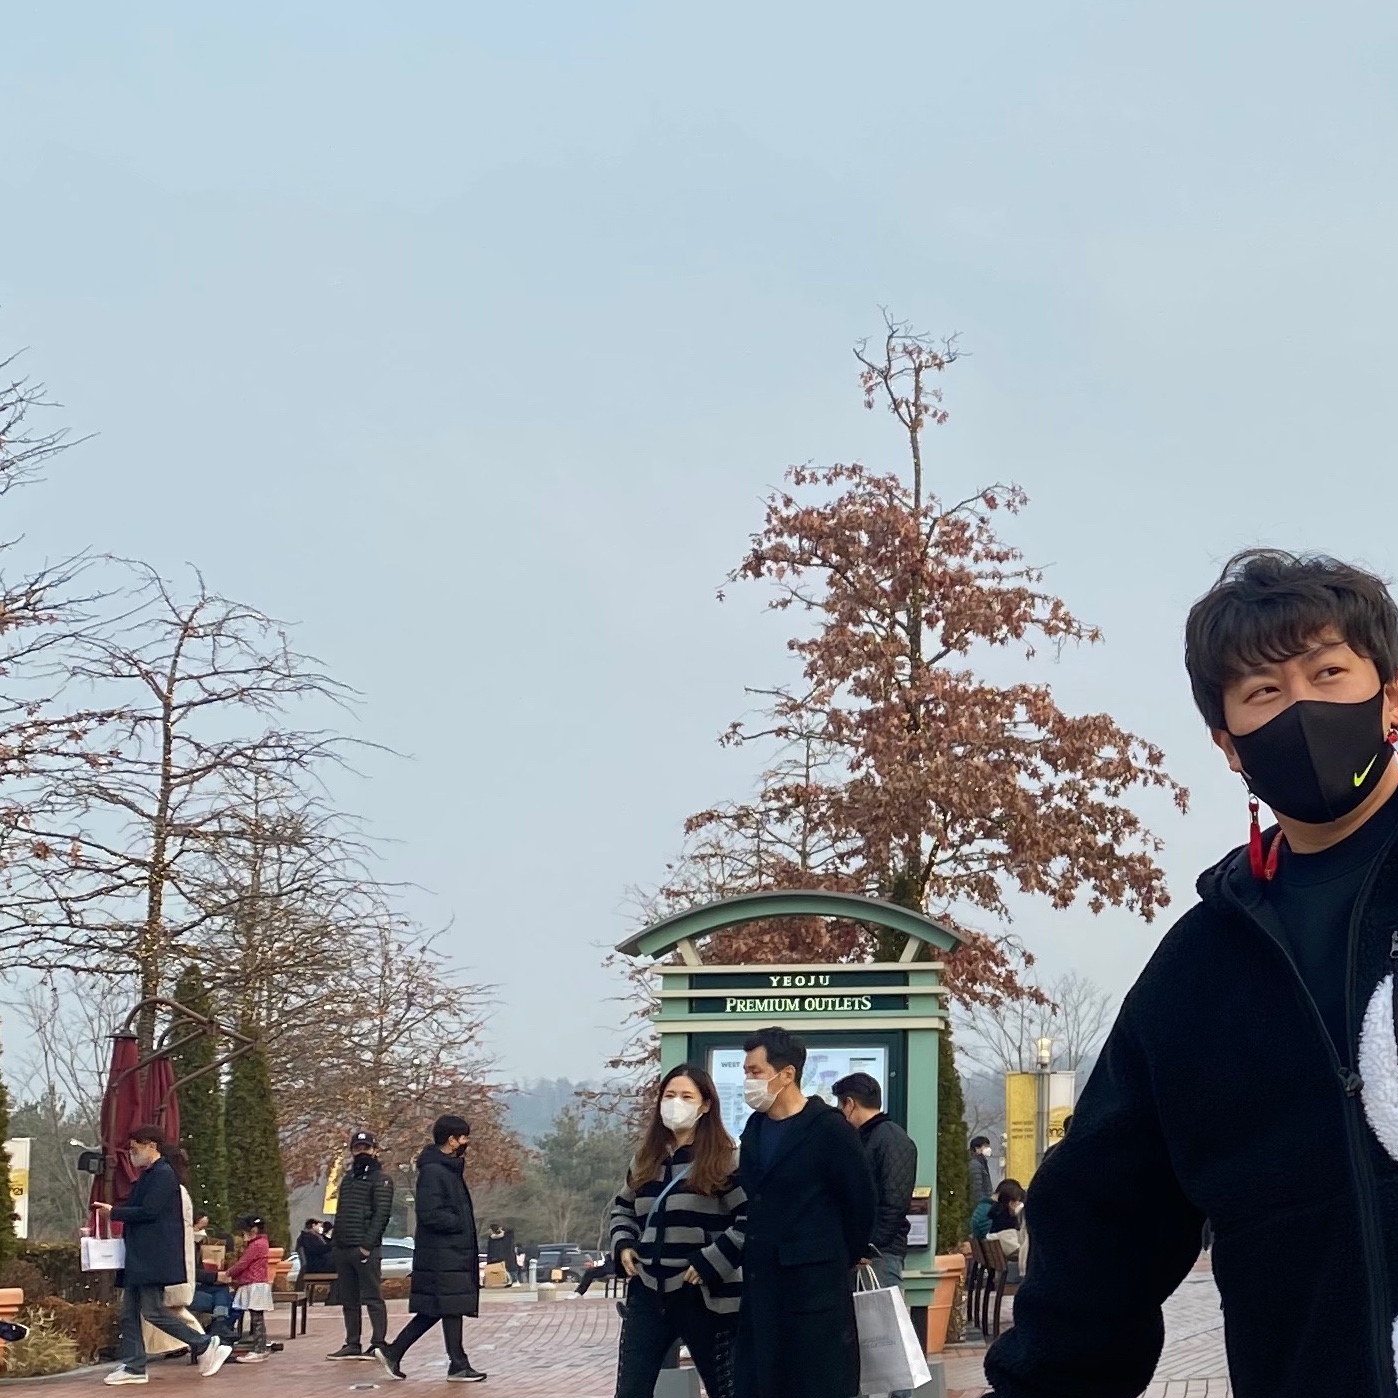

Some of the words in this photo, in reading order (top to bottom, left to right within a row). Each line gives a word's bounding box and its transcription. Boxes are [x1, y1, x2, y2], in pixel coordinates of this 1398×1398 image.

[769, 975, 831, 987] YEOJU
[725, 998, 800, 1012] PREMIUM
[804, 995, 872, 1011] OUTLETS
